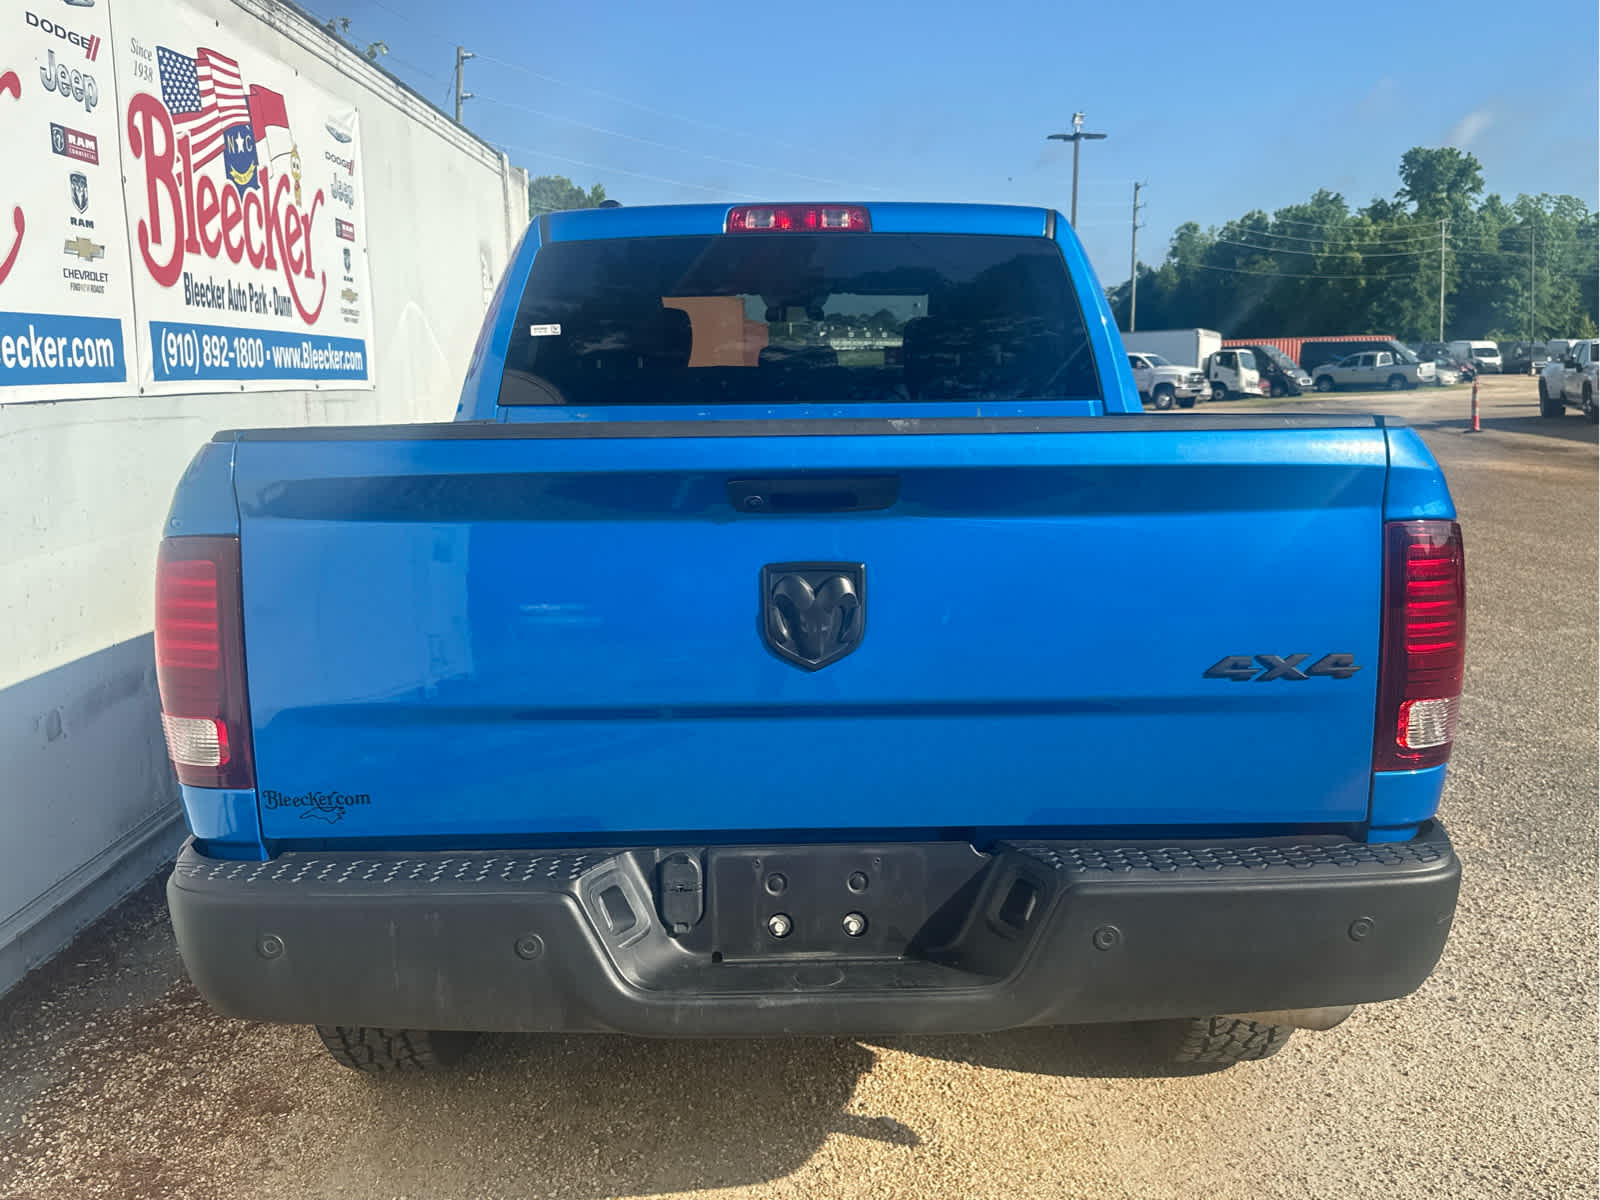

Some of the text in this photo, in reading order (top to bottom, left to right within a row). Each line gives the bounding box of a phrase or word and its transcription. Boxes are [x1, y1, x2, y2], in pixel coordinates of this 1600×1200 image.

[25, 11, 91, 50] DODGE
[130, 37, 152, 62] Since
[40, 49, 98, 113] Jeep
[134, 60, 153, 83] 1938
[68, 134, 96, 151] RAM
[70, 216, 94, 229] RAM
[127, 92, 326, 325] Bleecker
[63, 267, 109, 283] CHEVROLET
[183, 271, 225, 310] Bleecker
[228, 279, 248, 313] Auto
[248, 282, 268, 315] Park
[273, 286, 293, 318] Dunn
[0, 324, 115, 369] ecker.com
[161, 327, 200, 375] (910)
[203, 334, 264, 369] 892-1800
[272, 341, 364, 371] www.Bleecker.com
[263, 790, 371, 810] Bleecker.com
